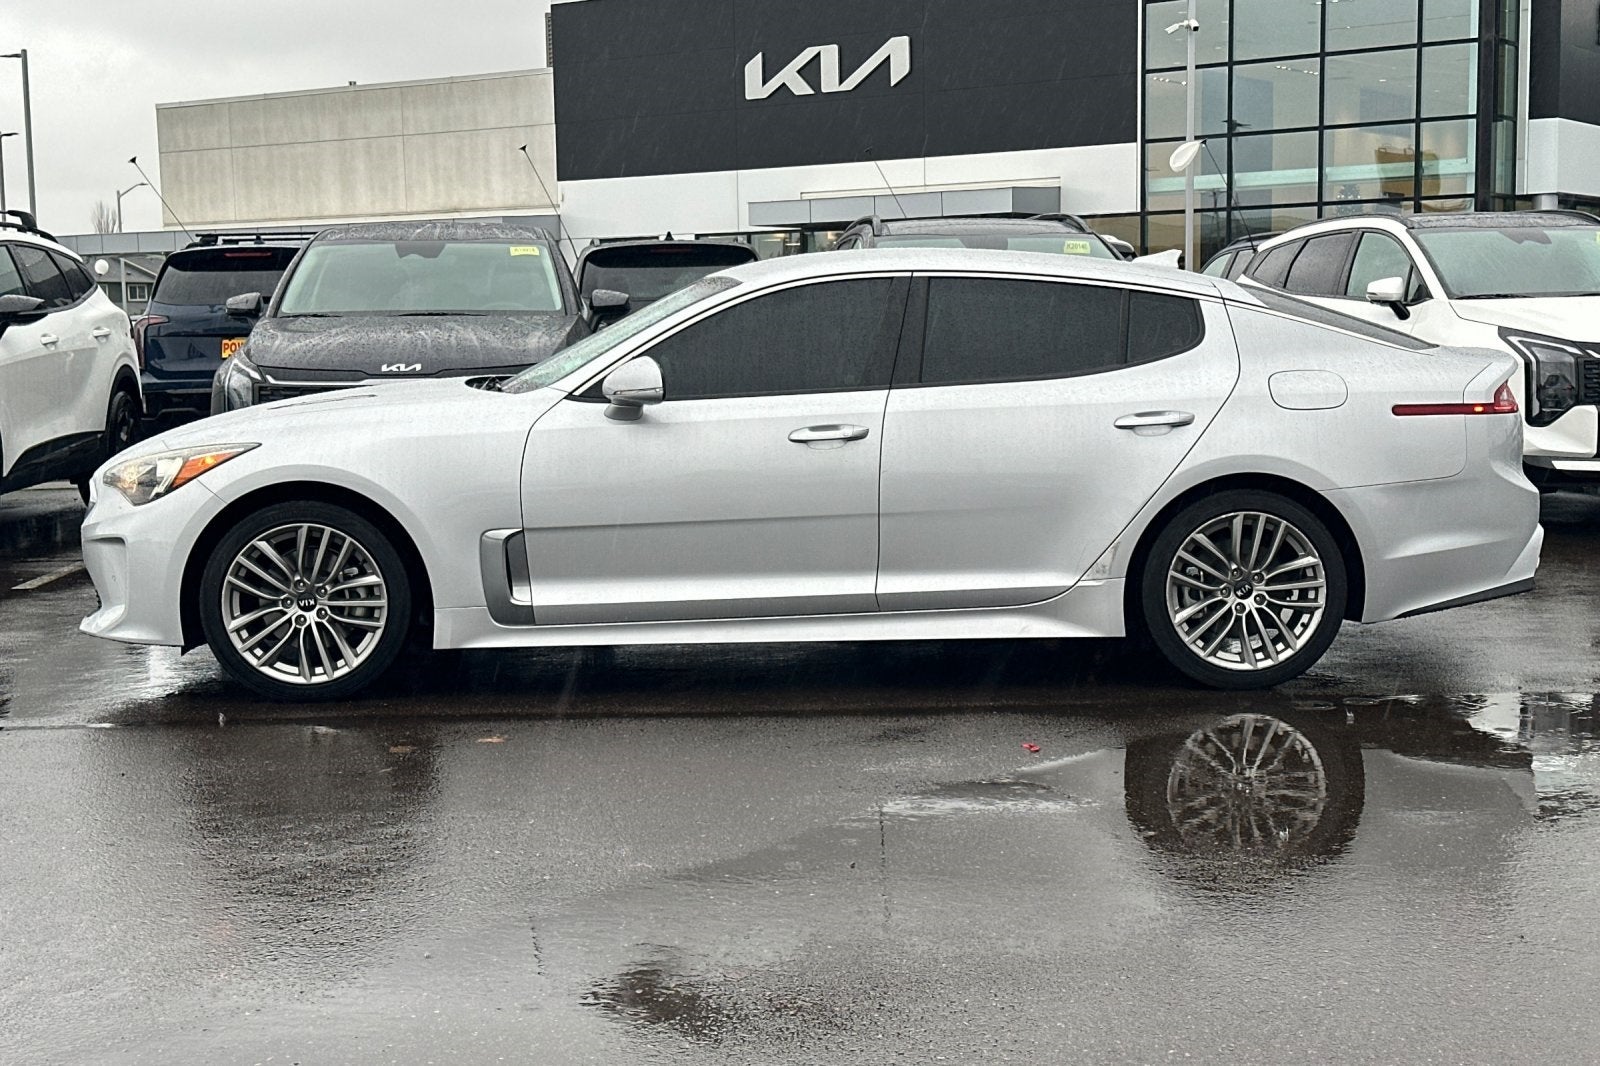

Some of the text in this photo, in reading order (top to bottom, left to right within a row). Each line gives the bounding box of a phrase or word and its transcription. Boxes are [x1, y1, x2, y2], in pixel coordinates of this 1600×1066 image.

[744, 35, 910, 100] KIA
[381, 363, 422, 372] KIA
[1236, 584, 1252, 597] KIA
[298, 599, 315, 607] KIA
